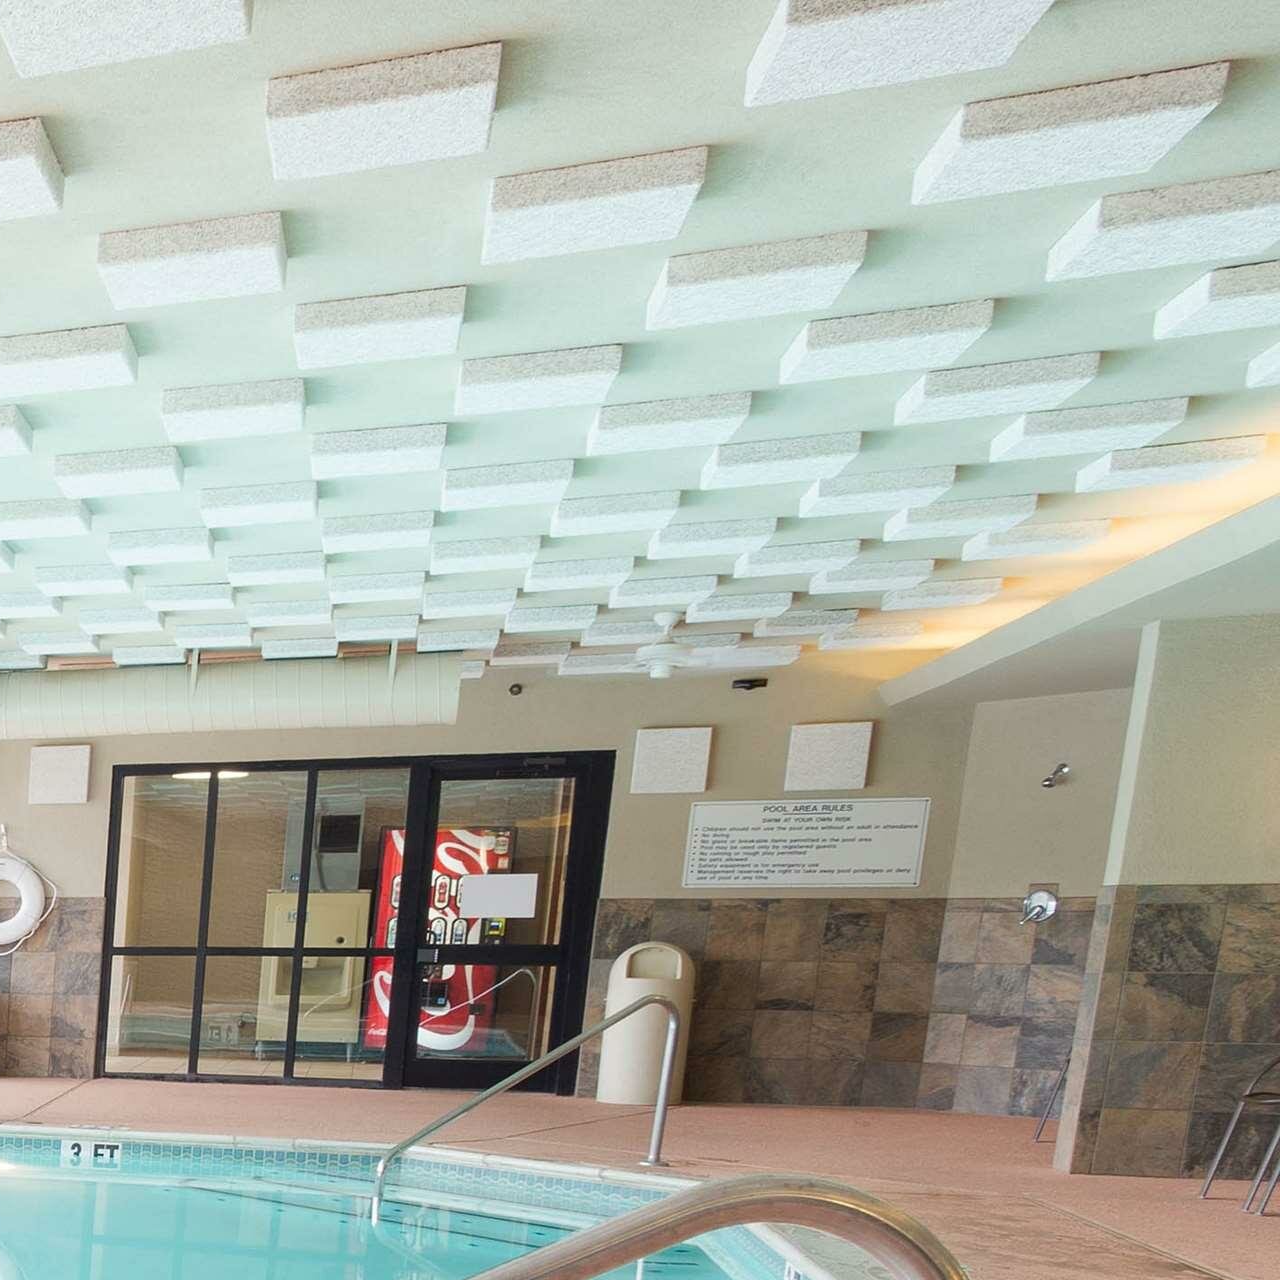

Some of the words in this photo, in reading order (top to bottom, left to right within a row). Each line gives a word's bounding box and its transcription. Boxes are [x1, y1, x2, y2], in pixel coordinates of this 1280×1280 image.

[762, 805, 790, 813] POOL
[792, 804, 818, 812] AREA
[821, 804, 854, 812] RULES
[70, 1142, 82, 1166] 3
[93, 1143, 120, 1168] FT
